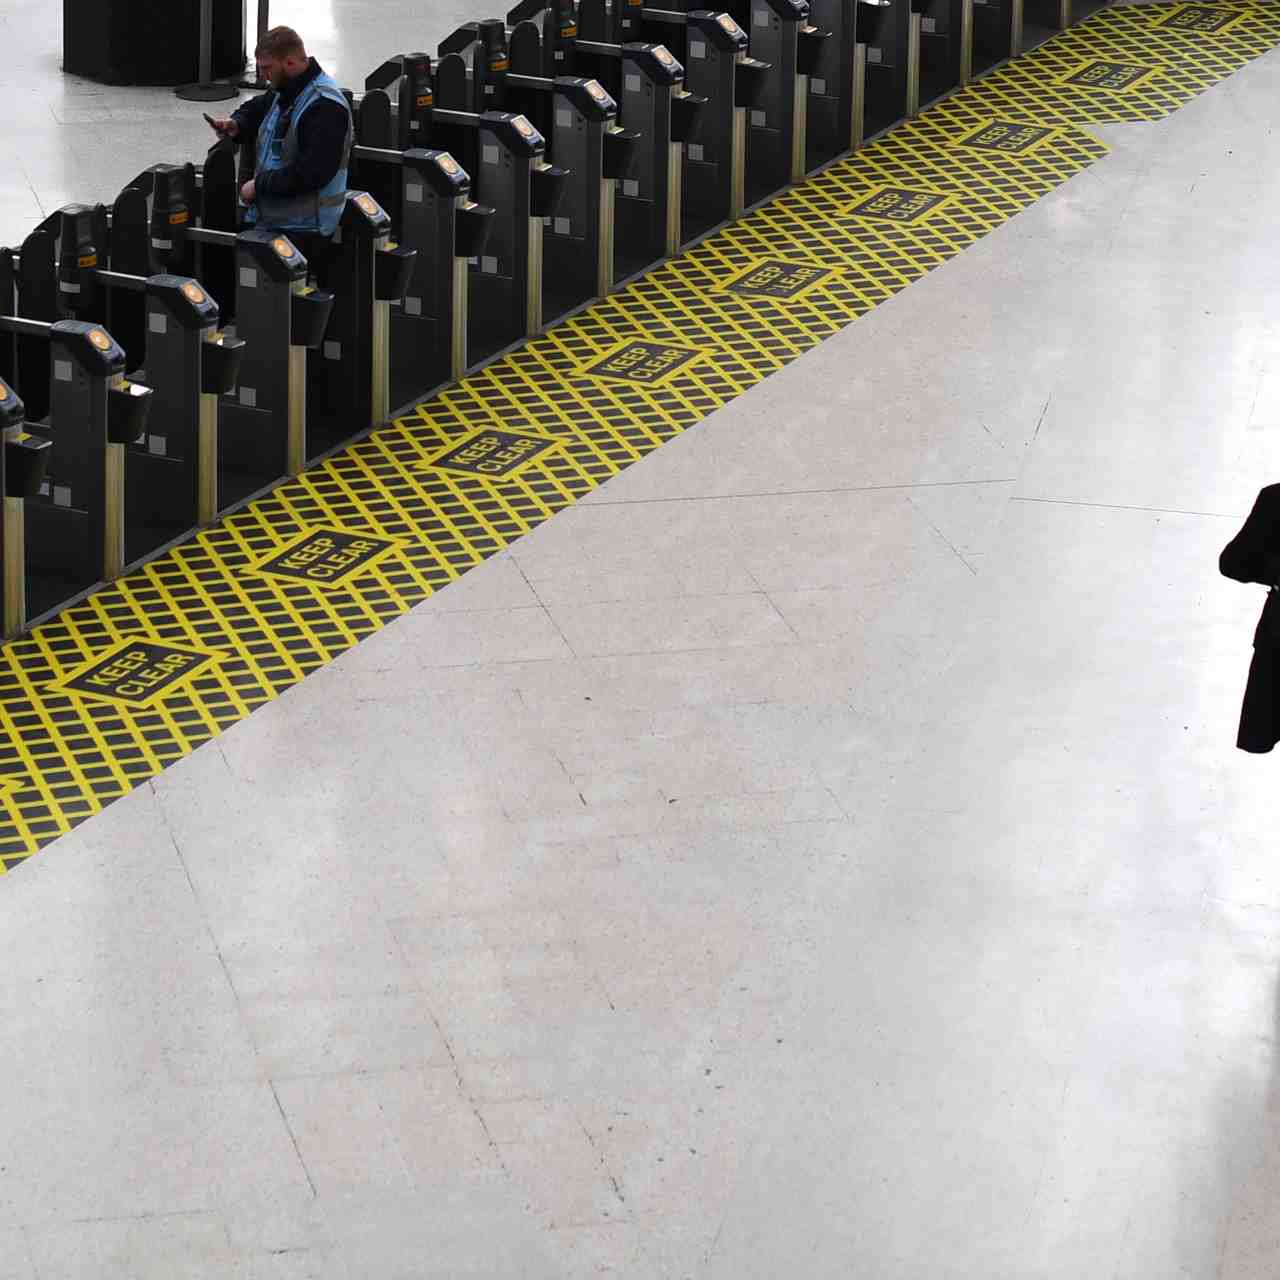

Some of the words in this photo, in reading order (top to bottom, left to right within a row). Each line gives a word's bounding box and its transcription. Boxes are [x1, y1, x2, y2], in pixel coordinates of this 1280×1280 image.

[600, 347, 651, 371] KEEP
[627, 350, 689, 379] CLEAR
[449, 437, 501, 464] KEEP
[476, 439, 538, 473] CLEAR
[277, 538, 338, 569] KEEP
[306, 539, 380, 578] CLEAR
[85, 651, 148, 686] KEEP
[115, 654, 195, 697] CLEAR
